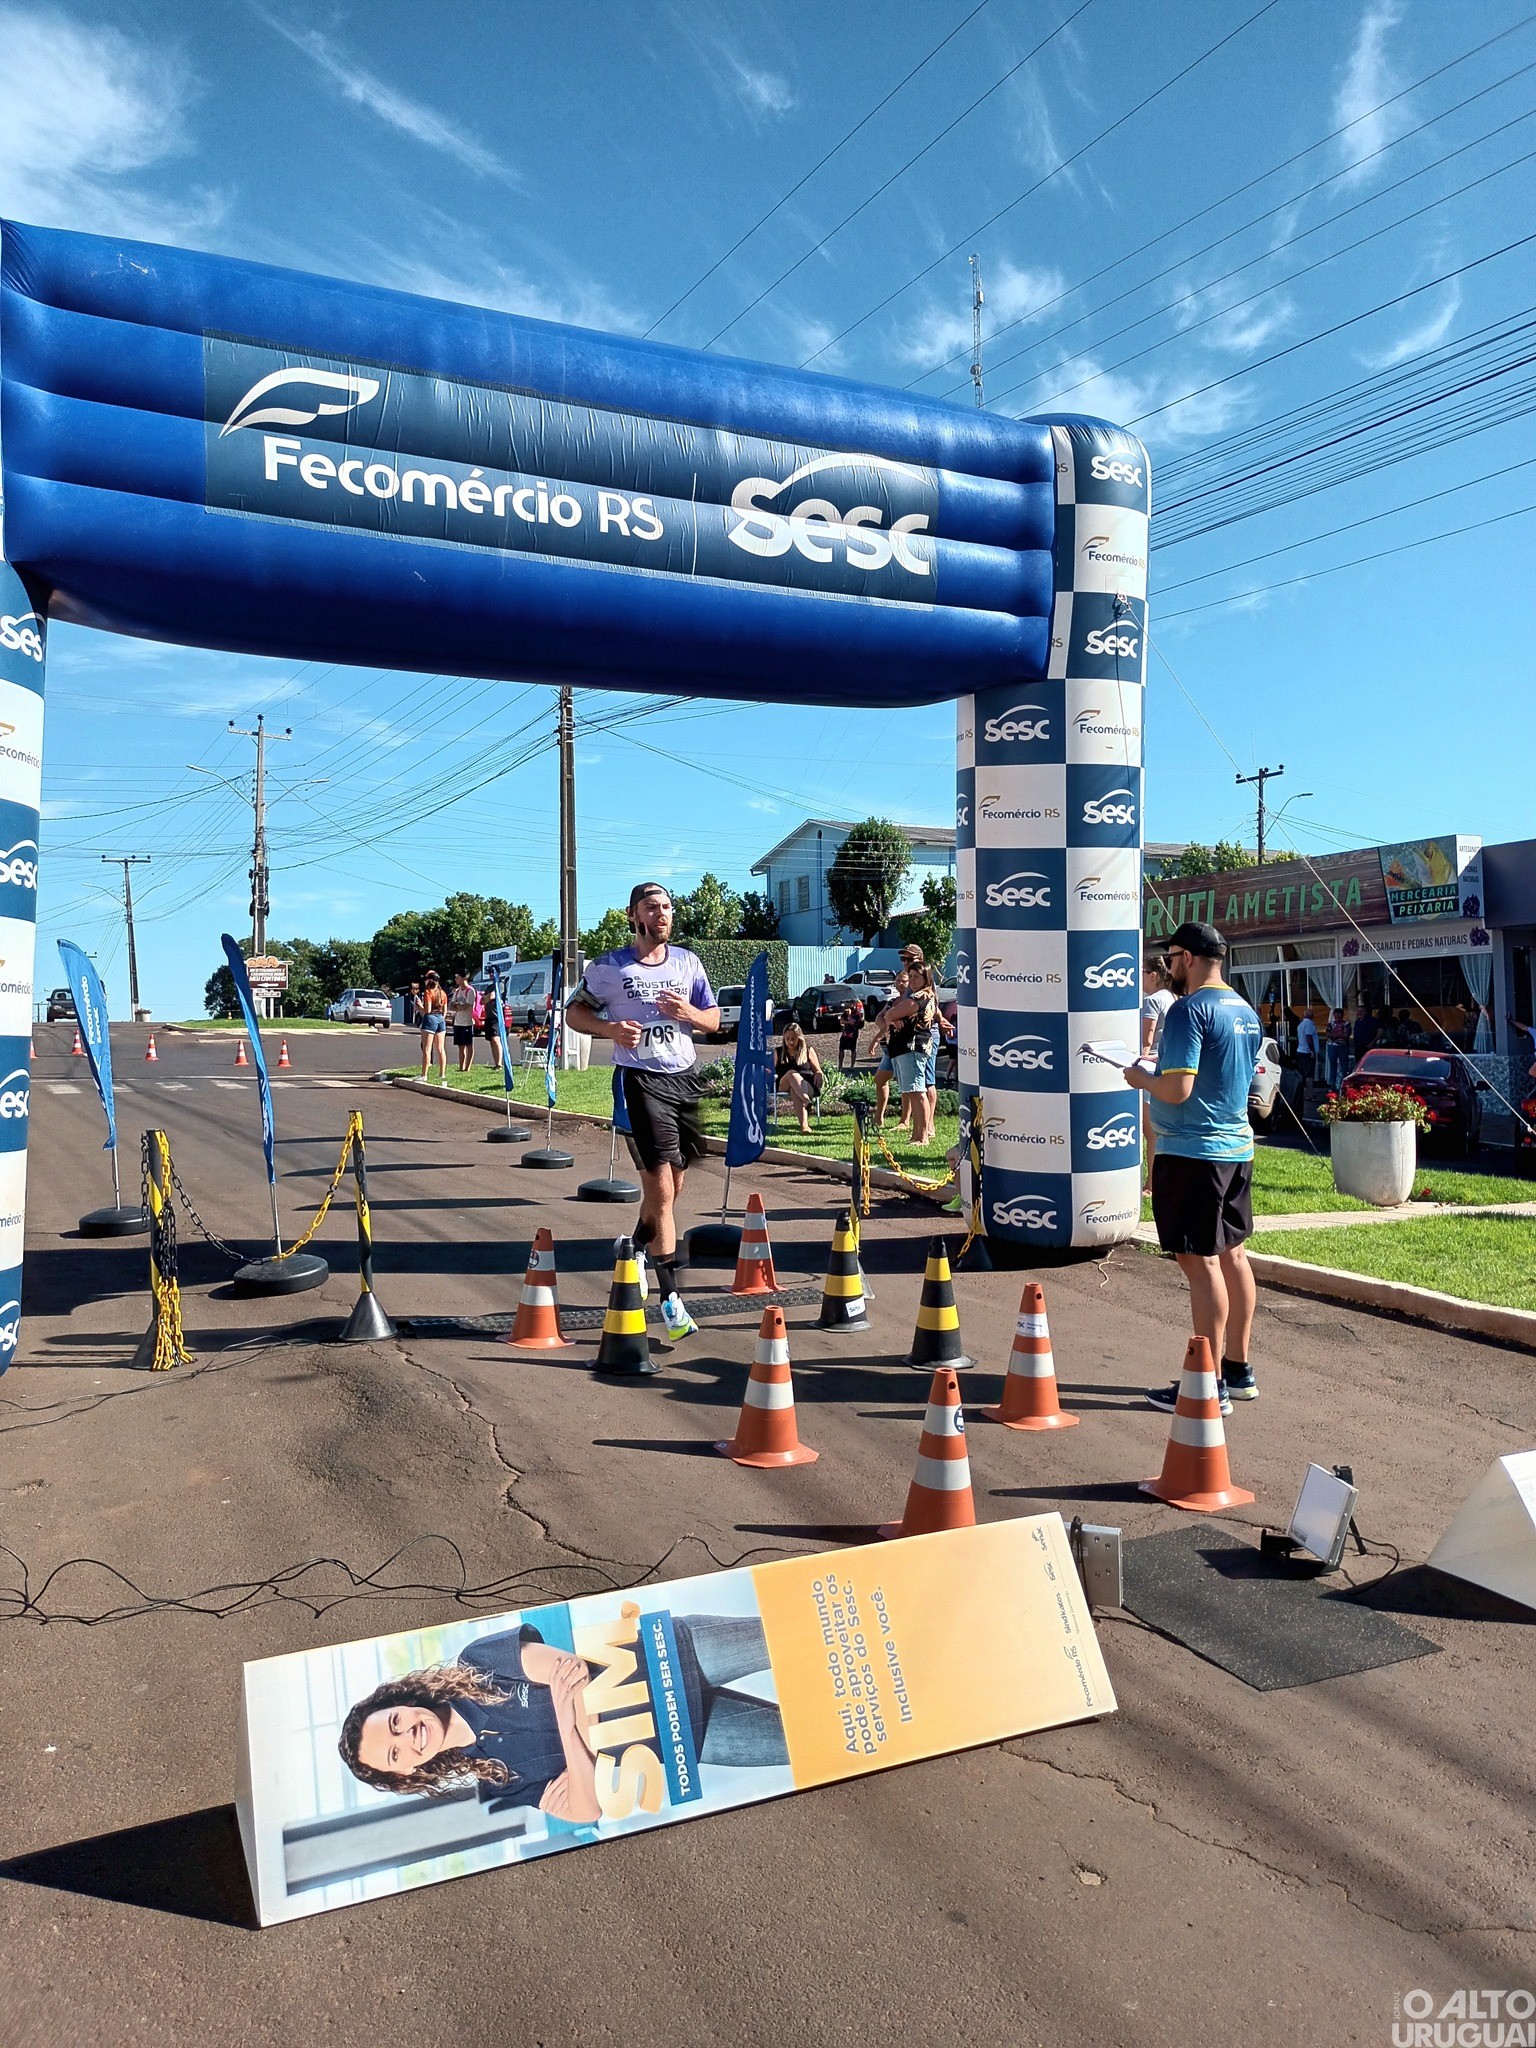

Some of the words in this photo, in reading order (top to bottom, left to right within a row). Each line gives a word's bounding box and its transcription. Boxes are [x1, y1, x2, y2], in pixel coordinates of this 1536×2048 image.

[1091, 450, 1143, 488] Sesc
[264, 435, 583, 528] Fecomércio
[598, 491, 664, 541] RS
[727, 453, 931, 576] Sesc
[1088, 550, 1138, 566] Fecomércio
[0, 612, 46, 663] Ses
[1084, 619, 1139, 659] Sesc
[984, 704, 1050, 742] Sesc
[1079, 722, 1132, 736] Fecomércio
[982, 808, 1041, 819] Fecomércio
[1044, 808, 1061, 818] RS
[1082, 788, 1135, 825] Sesc
[986, 871, 1051, 907] Sesc
[1080, 889, 1131, 901] Fecomércio
[1225, 876, 1362, 922] AMETISTA
[1391, 885, 1457, 903] MERCEARIA
[1399, 900, 1454, 916] PEIXARIA
[1361, 941, 1400, 953] ARTESANATO
[1402, 941, 1407, 950] E
[1407, 938, 1434, 950] PEDRAS
[1434, 934, 1468, 947] NATURAIS
[984, 971, 1043, 983] Fecomércio
[1046, 973, 1062, 983] RS
[1083, 952, 1135, 989] Sesc
[627, 989, 650, 999] DAS
[641, 1024, 675, 1048] 796
[988, 1035, 1054, 1069] Sesc
[987, 1129, 1046, 1145] Fecomércio
[1049, 1135, 1065, 1145] RS
[1086, 1112, 1136, 1150] Sesc
[992, 1194, 1058, 1230] Sesc
[1086, 1209, 1133, 1224] Fecomércio
[826, 1573, 838, 1595] os
[812, 1580, 835, 1646] mundo
[842, 1579, 860, 1628] Sesc.
[870, 1586, 891, 1635] você.
[652, 1618, 670, 1658] SESC.
[831, 1601, 862, 1698] aproveitar
[853, 1633, 867, 1658] do
[659, 1659, 673, 1687] SER
[828, 1651, 846, 1698] todo
[885, 1640, 913, 1723] Inclusive
[665, 1690, 682, 1740] PODEM
[861, 1663, 887, 1742] serviços
[838, 1702, 859, 1753] Aqui,
[854, 1703, 878, 1755] pode
[675, 1743, 692, 1797] TODOS
